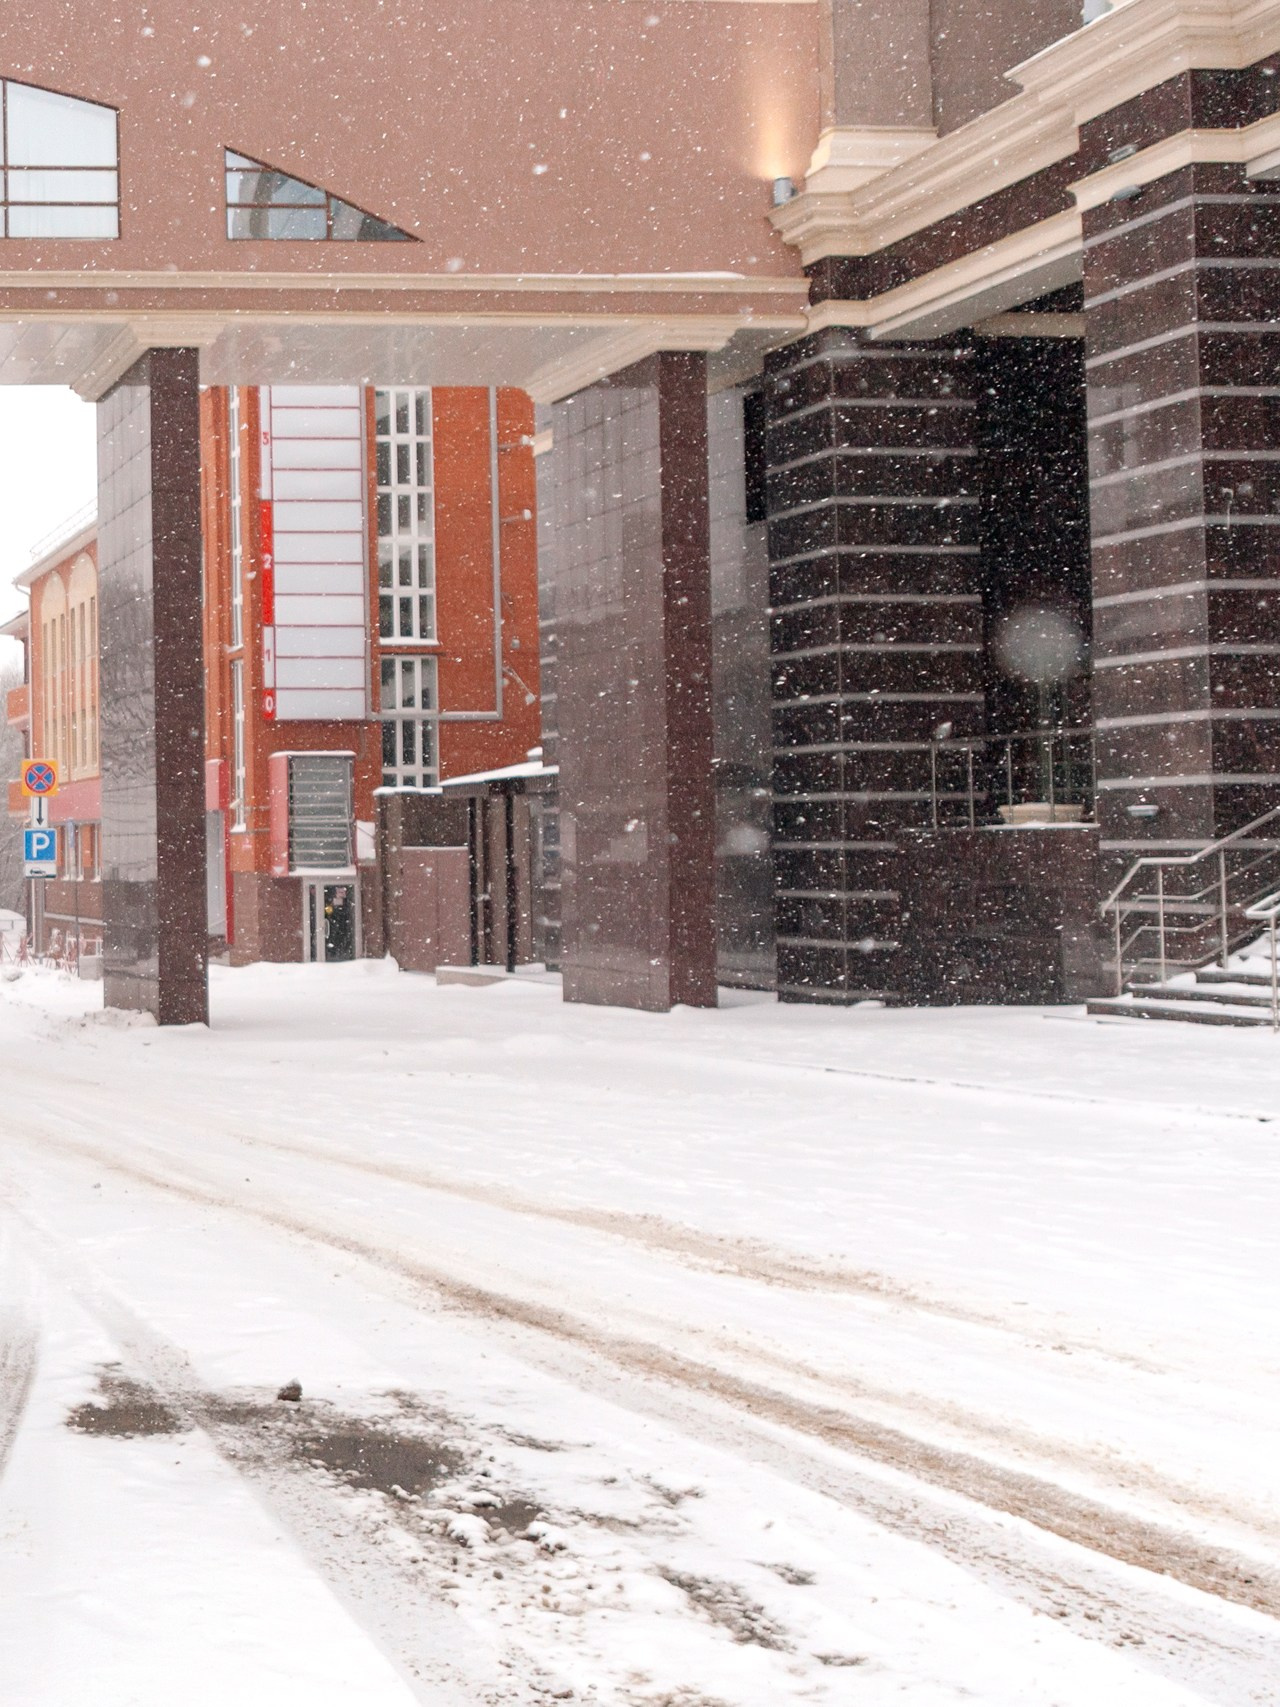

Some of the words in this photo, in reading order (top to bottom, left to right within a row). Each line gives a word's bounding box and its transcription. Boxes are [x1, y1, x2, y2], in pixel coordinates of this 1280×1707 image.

[262, 431, 269, 445] 3
[264, 553, 271, 568] 2
[265, 649, 271, 662] 1
[265, 695, 273, 711] 0
[32, 832, 50, 858] P
